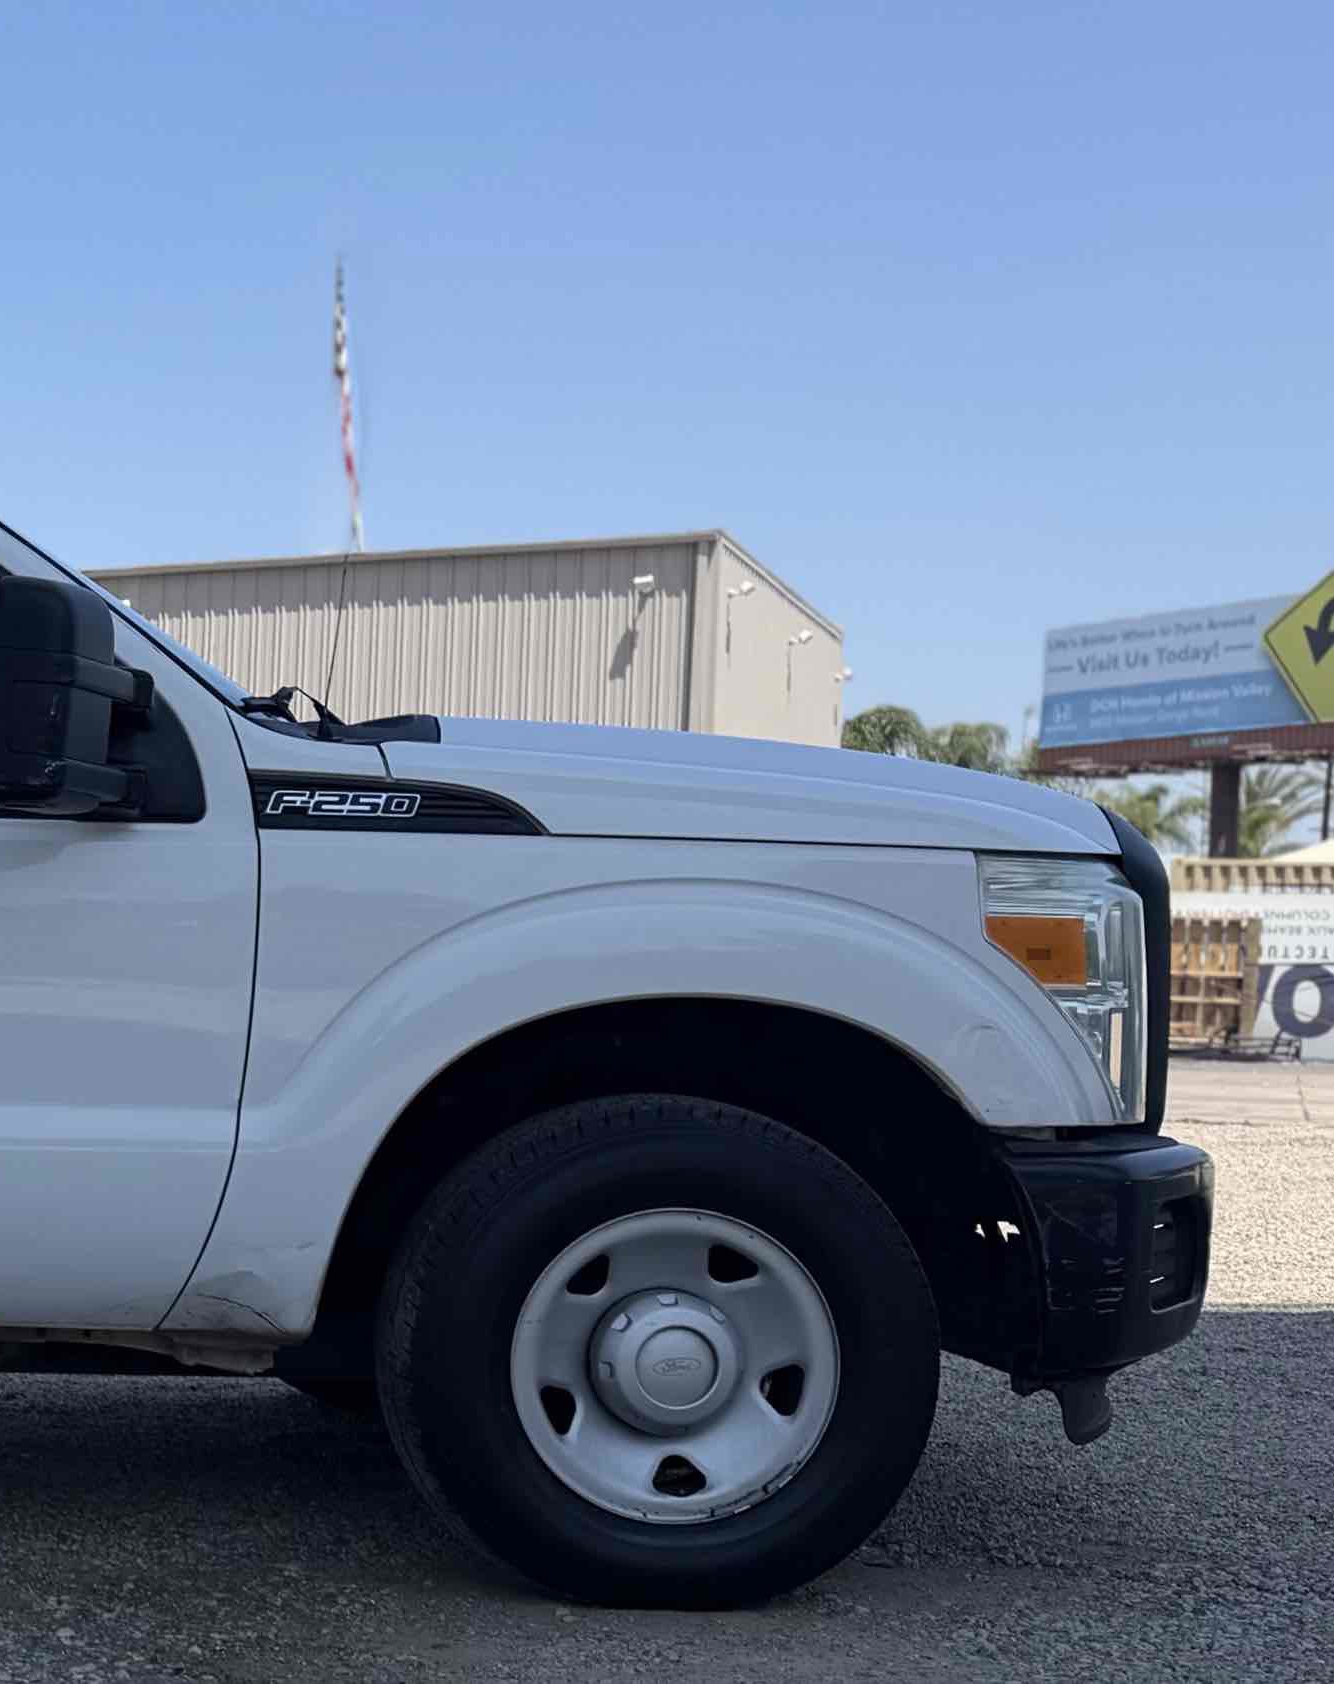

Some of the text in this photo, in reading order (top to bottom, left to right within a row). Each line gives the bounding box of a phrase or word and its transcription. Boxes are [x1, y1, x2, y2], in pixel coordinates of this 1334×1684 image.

[1076, 640, 1220, 674] Visit Us Today!
[265, 790, 421, 818] F-250
[1267, 945, 1330, 960] TECTU
